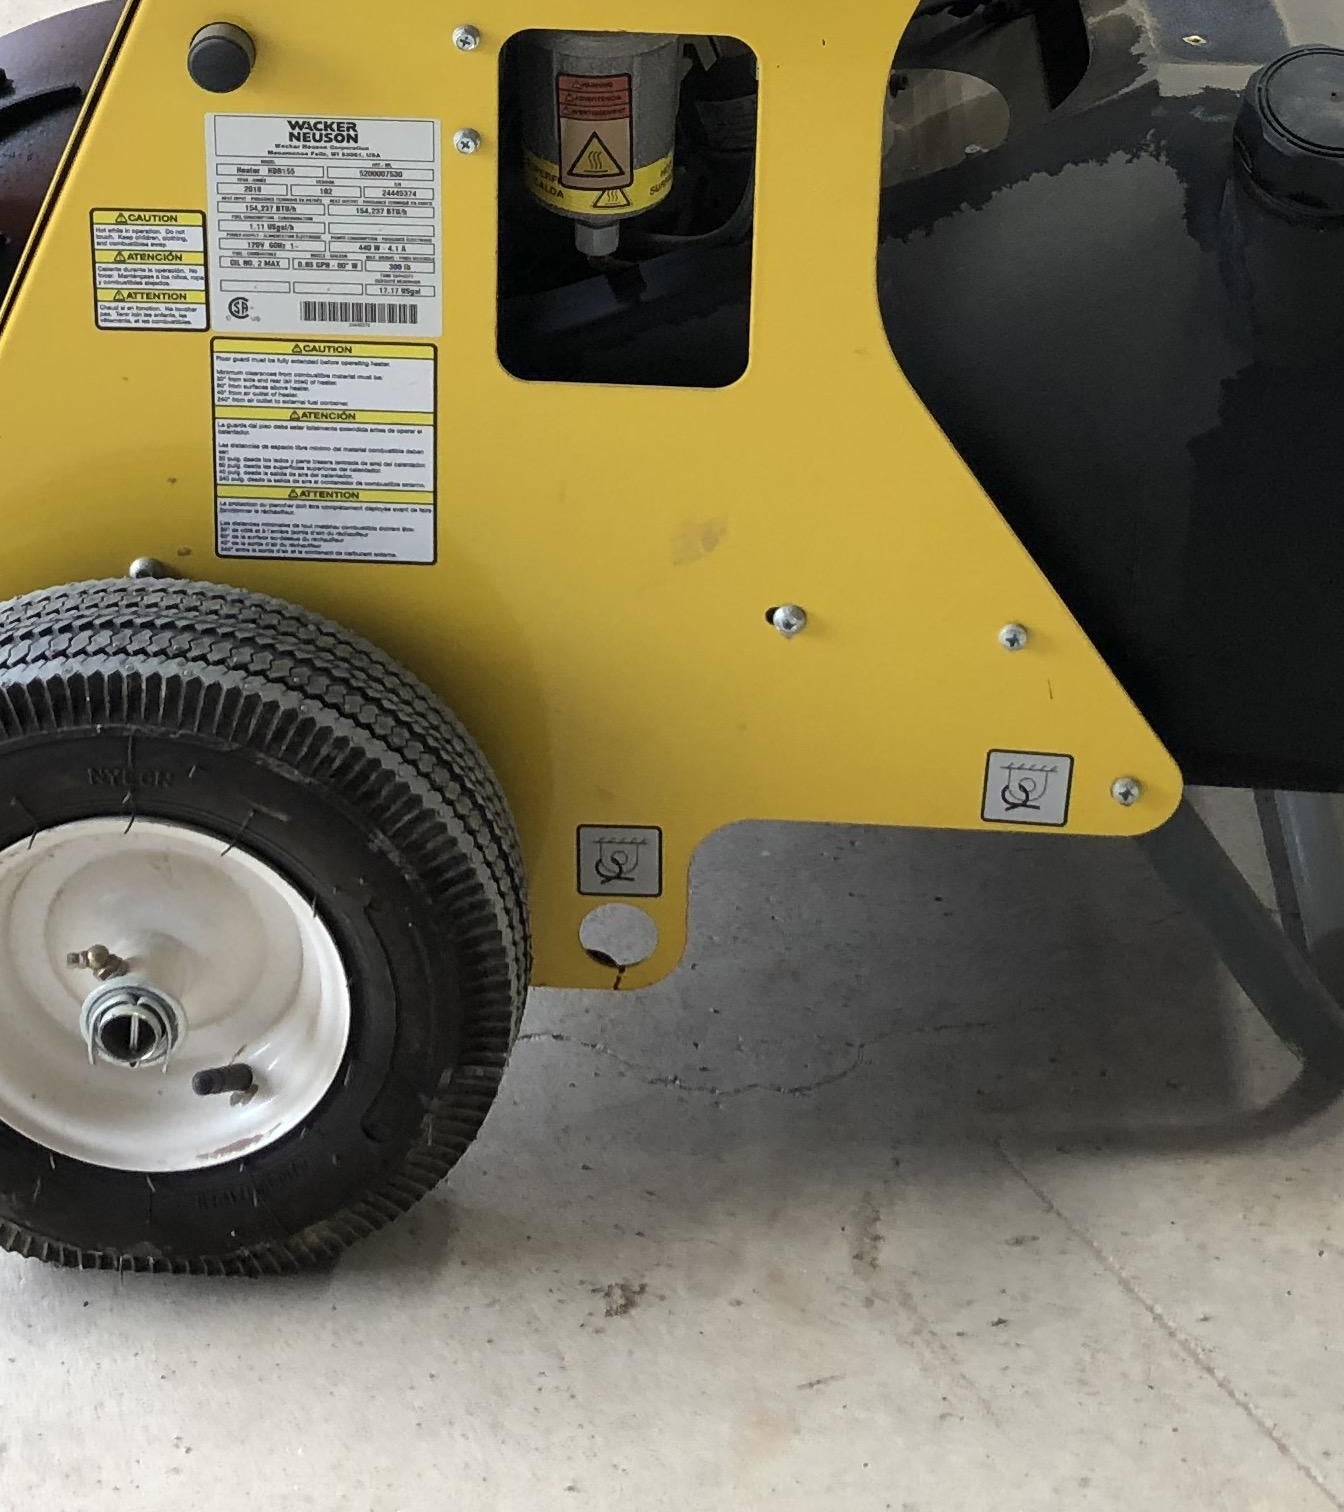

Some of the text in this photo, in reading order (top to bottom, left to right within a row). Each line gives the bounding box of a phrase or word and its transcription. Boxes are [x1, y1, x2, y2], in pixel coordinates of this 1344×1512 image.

[286, 119, 358, 133] WACKER
[288, 131, 359, 144] NEUSON
[127, 213, 178, 223] CAUTION
[126, 250, 183, 261] ATENCIÓN
[126, 291, 187, 300] ATTENTION
[303, 344, 353, 354] CAUTION
[301, 410, 356, 420] ATENCIÓN
[299, 490, 360, 499] ATTENTION
